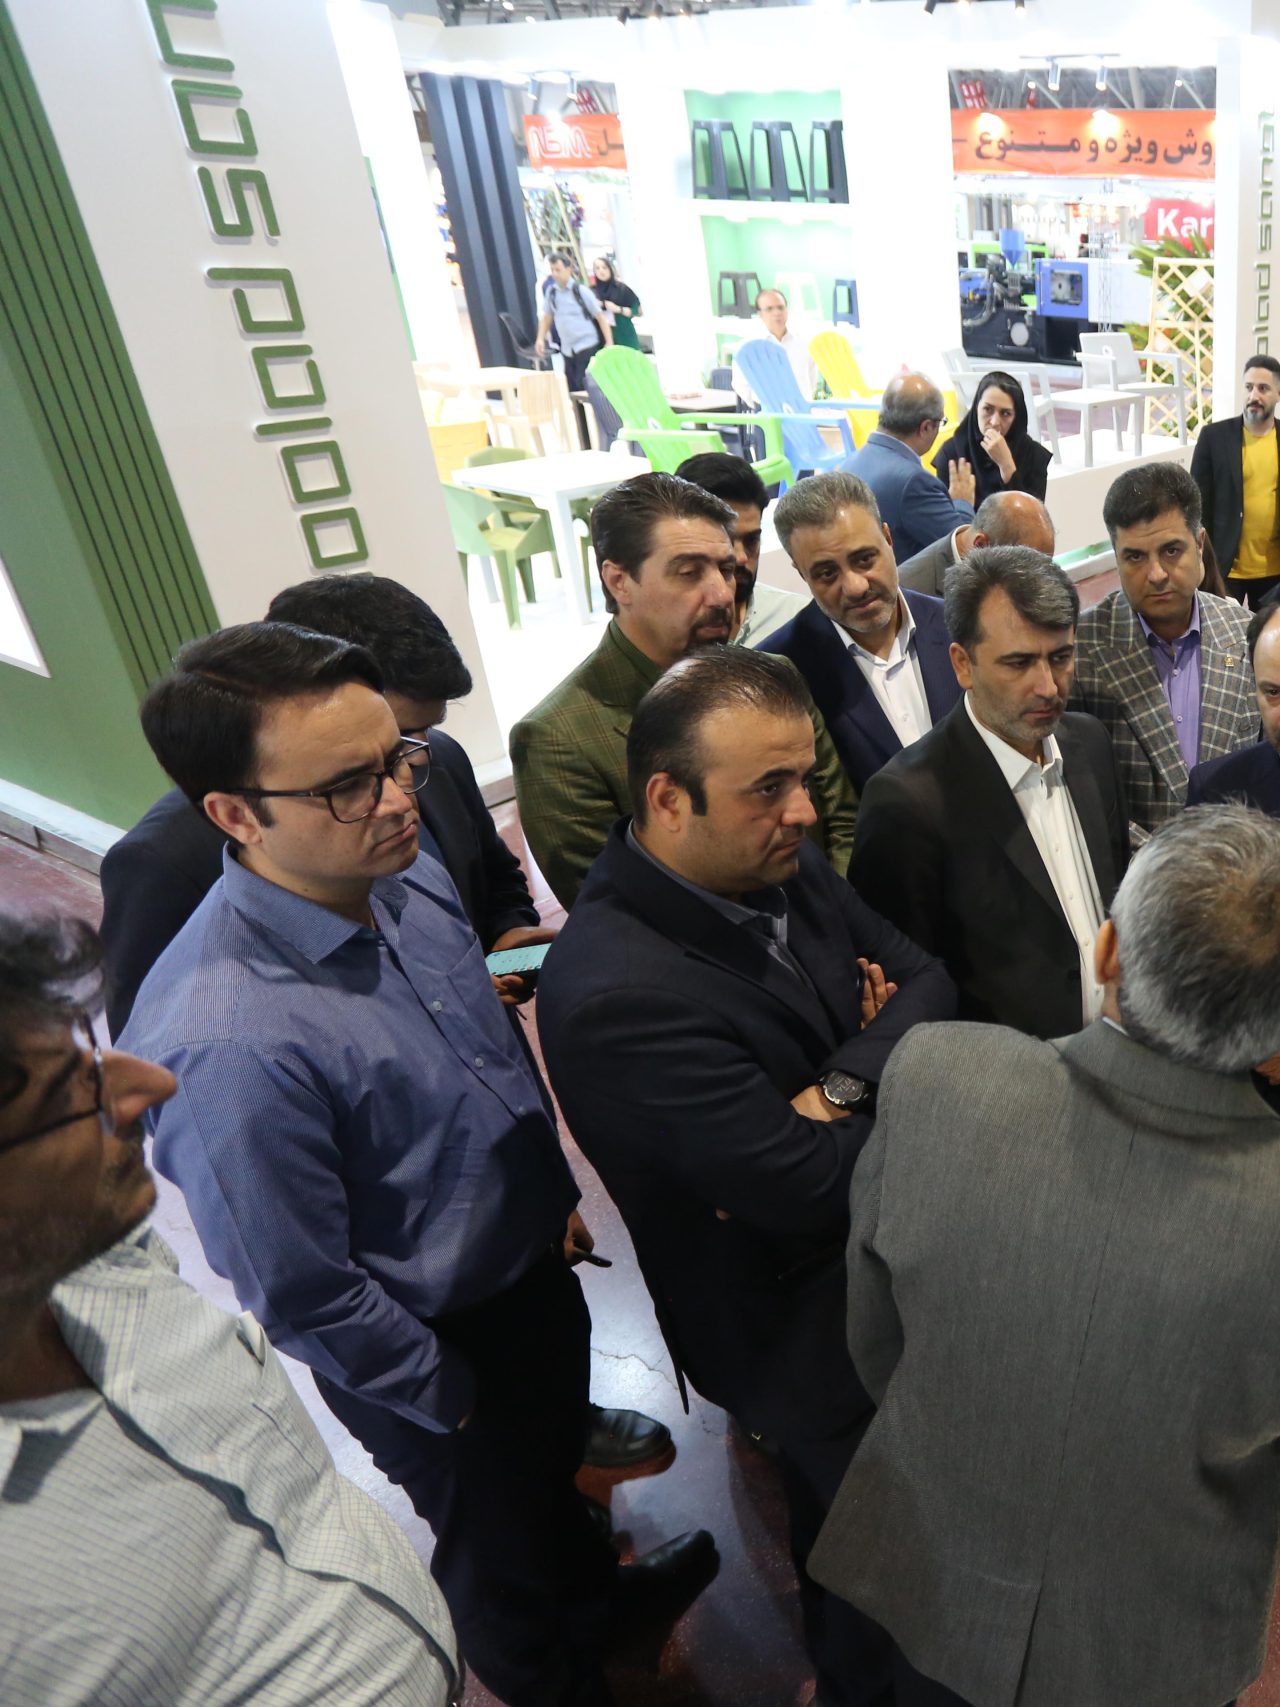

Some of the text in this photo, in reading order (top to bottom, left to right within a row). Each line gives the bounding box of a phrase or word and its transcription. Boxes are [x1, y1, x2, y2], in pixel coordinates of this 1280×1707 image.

[146, 0, 370, 577] oolad san
[1104, 129, 1158, 163] ویژه
